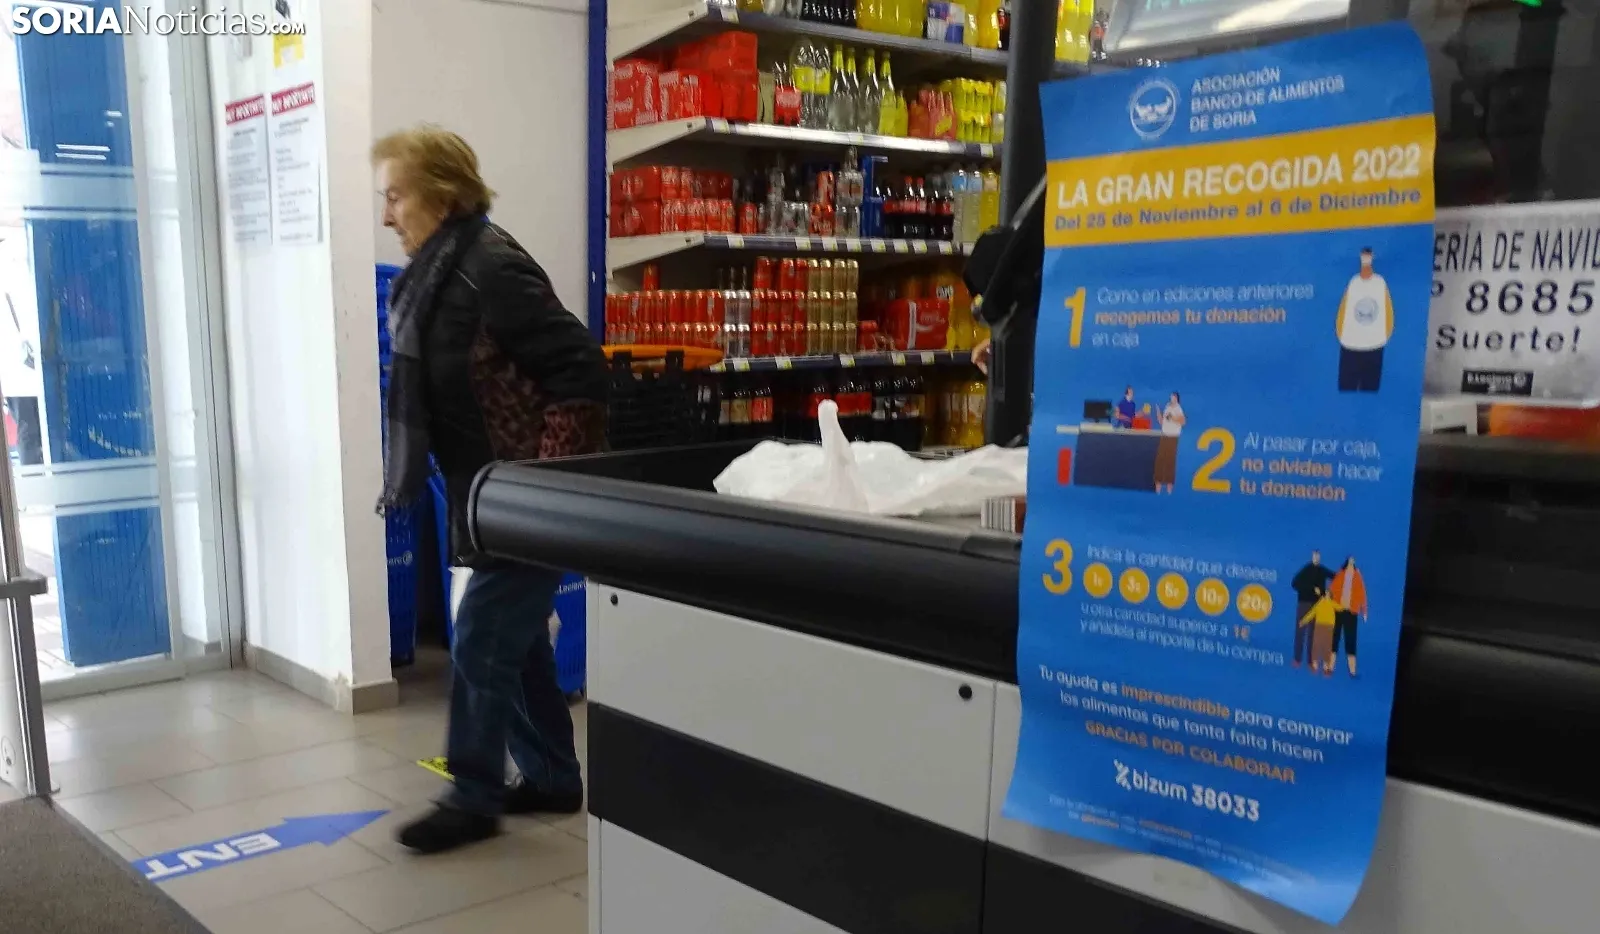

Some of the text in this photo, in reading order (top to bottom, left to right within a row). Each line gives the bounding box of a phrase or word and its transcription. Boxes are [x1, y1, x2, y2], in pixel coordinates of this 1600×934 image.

[1190, 66, 1281, 95] ASOCIACIÓN
[1191, 75, 1344, 114] BANCO DE ALIMENTOS
[1189, 111, 1257, 133] DE SORIA
[1057, 142, 1421, 210] LA GRAN RECOGIDA 2022
[1055, 184, 1422, 231] Del 25 de Noviembre al 6 de Diciembre
[1492, 230, 1525, 271] DE
[1097, 282, 1314, 304] Como en ediciones anteriores
[1063, 287, 1087, 349] 1
[1094, 305, 1287, 328] recogemos tu donación
[1091, 331, 1140, 350] en caja
[1435, 323, 1581, 353] Suerte!
[1191, 426, 1236, 494] 2
[1243, 431, 1381, 460] Al pasar por caja,
[1241, 456, 1384, 482] no olvides hacer
[1238, 477, 1347, 502] tu donación
[1042, 538, 1073, 596] 3
[1086, 543, 1123, 563] Indica
[1124, 548, 1136, 565] la
[1138, 551, 1194, 573] cantidad
[1196, 559, 1223, 577] que
[1089, 603, 1113, 618] otra
[1114, 607, 1165, 628] cantidad
[1167, 615, 1218, 637] superior
[1219, 622, 1229, 638] a
[1135, 626, 1147, 642] al
[1148, 628, 1196, 652] importe
[1197, 638, 1215, 655] de
[1216, 640, 1230, 657] tu
[1231, 645, 1285, 666] compra
[1039, 664, 1354, 746] Tu ayuda es imprescindible para comprar
[1060, 688, 1325, 765] los alimentos que tanta falta hacen
[1085, 719, 1296, 785] GRACIAS POR COLABORAR
[1132, 768, 1261, 823] bizum 38033
[144, 832, 282, 880] ENT
